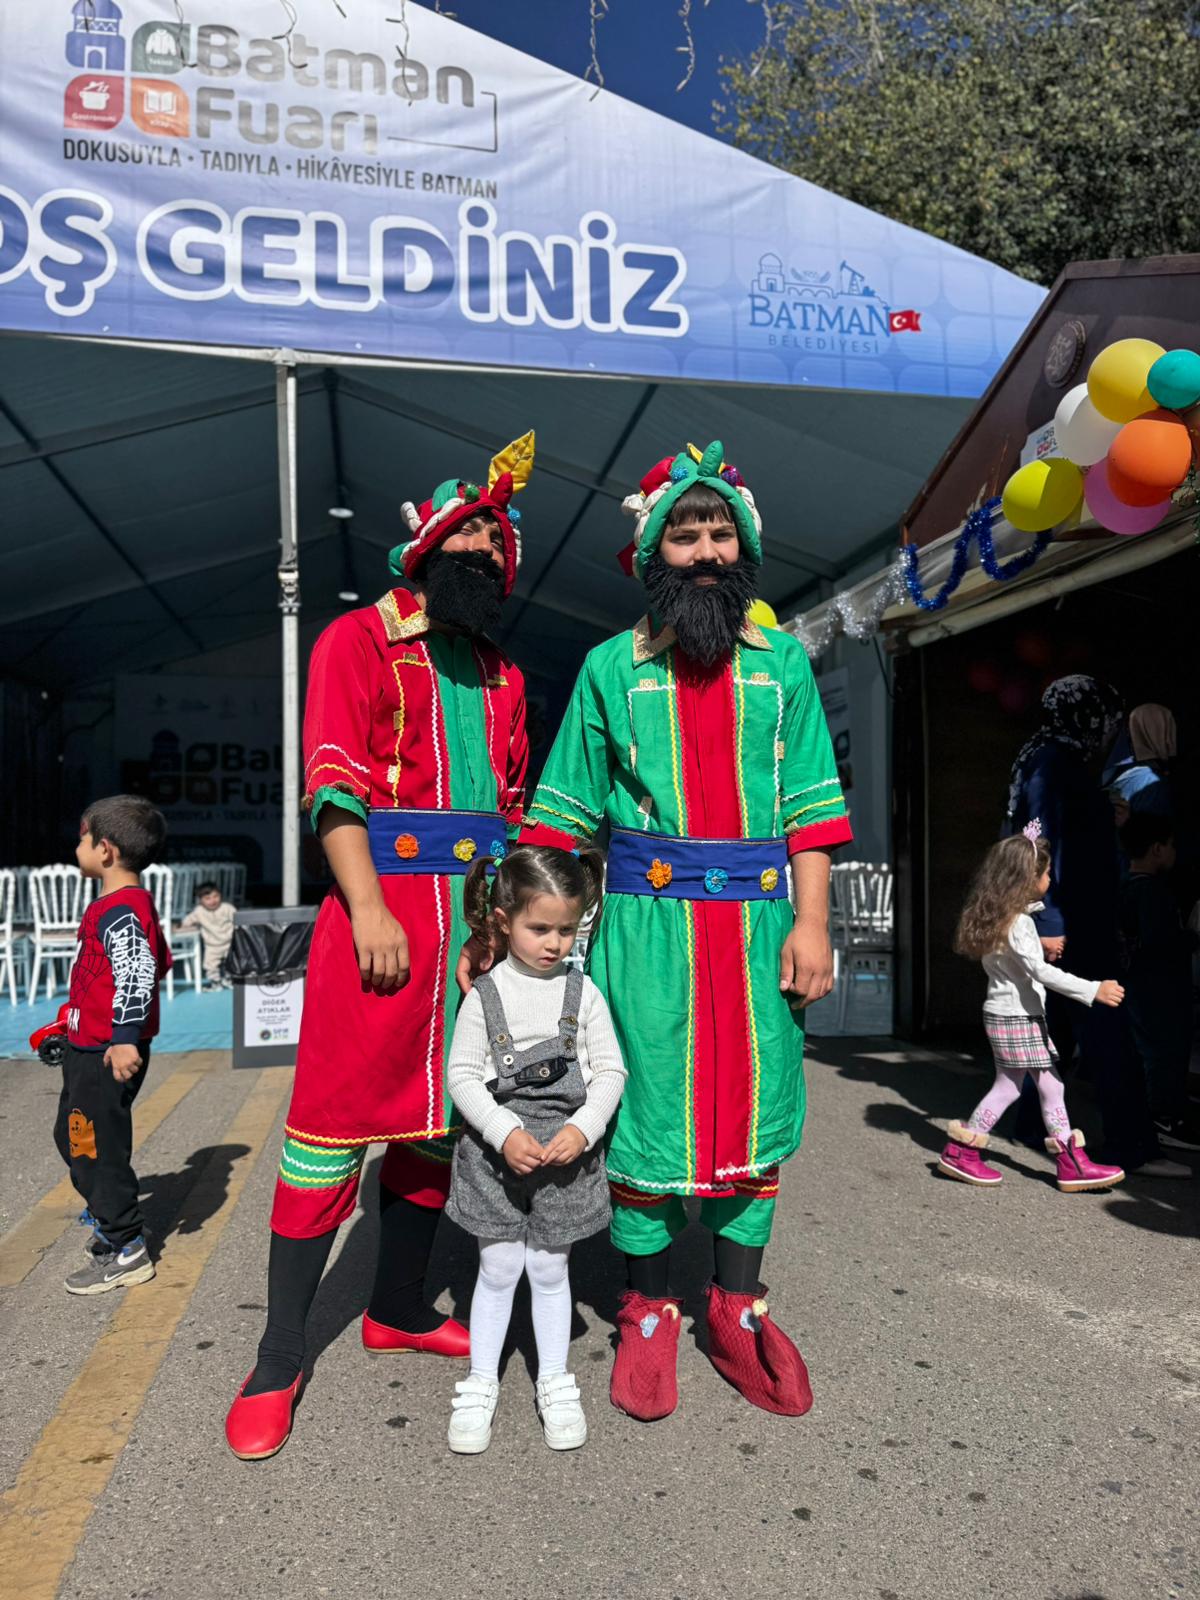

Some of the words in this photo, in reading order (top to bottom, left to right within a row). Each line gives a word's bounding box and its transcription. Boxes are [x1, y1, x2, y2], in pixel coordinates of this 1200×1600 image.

[197, 24, 474, 108] Batman
[196, 86, 378, 156] Fuarı
[63, 138, 181, 167] DOKUSUYLA
[200, 150, 280, 176] TADIYLA
[297, 154, 415, 190] HİKÂYESİYLE
[422, 172, 497, 199] BATMAN
[137, 198, 689, 337] GELDİNİZ
[748, 294, 891, 337] BATMAN
[768, 334, 880, 354] BELEDİYESİ
